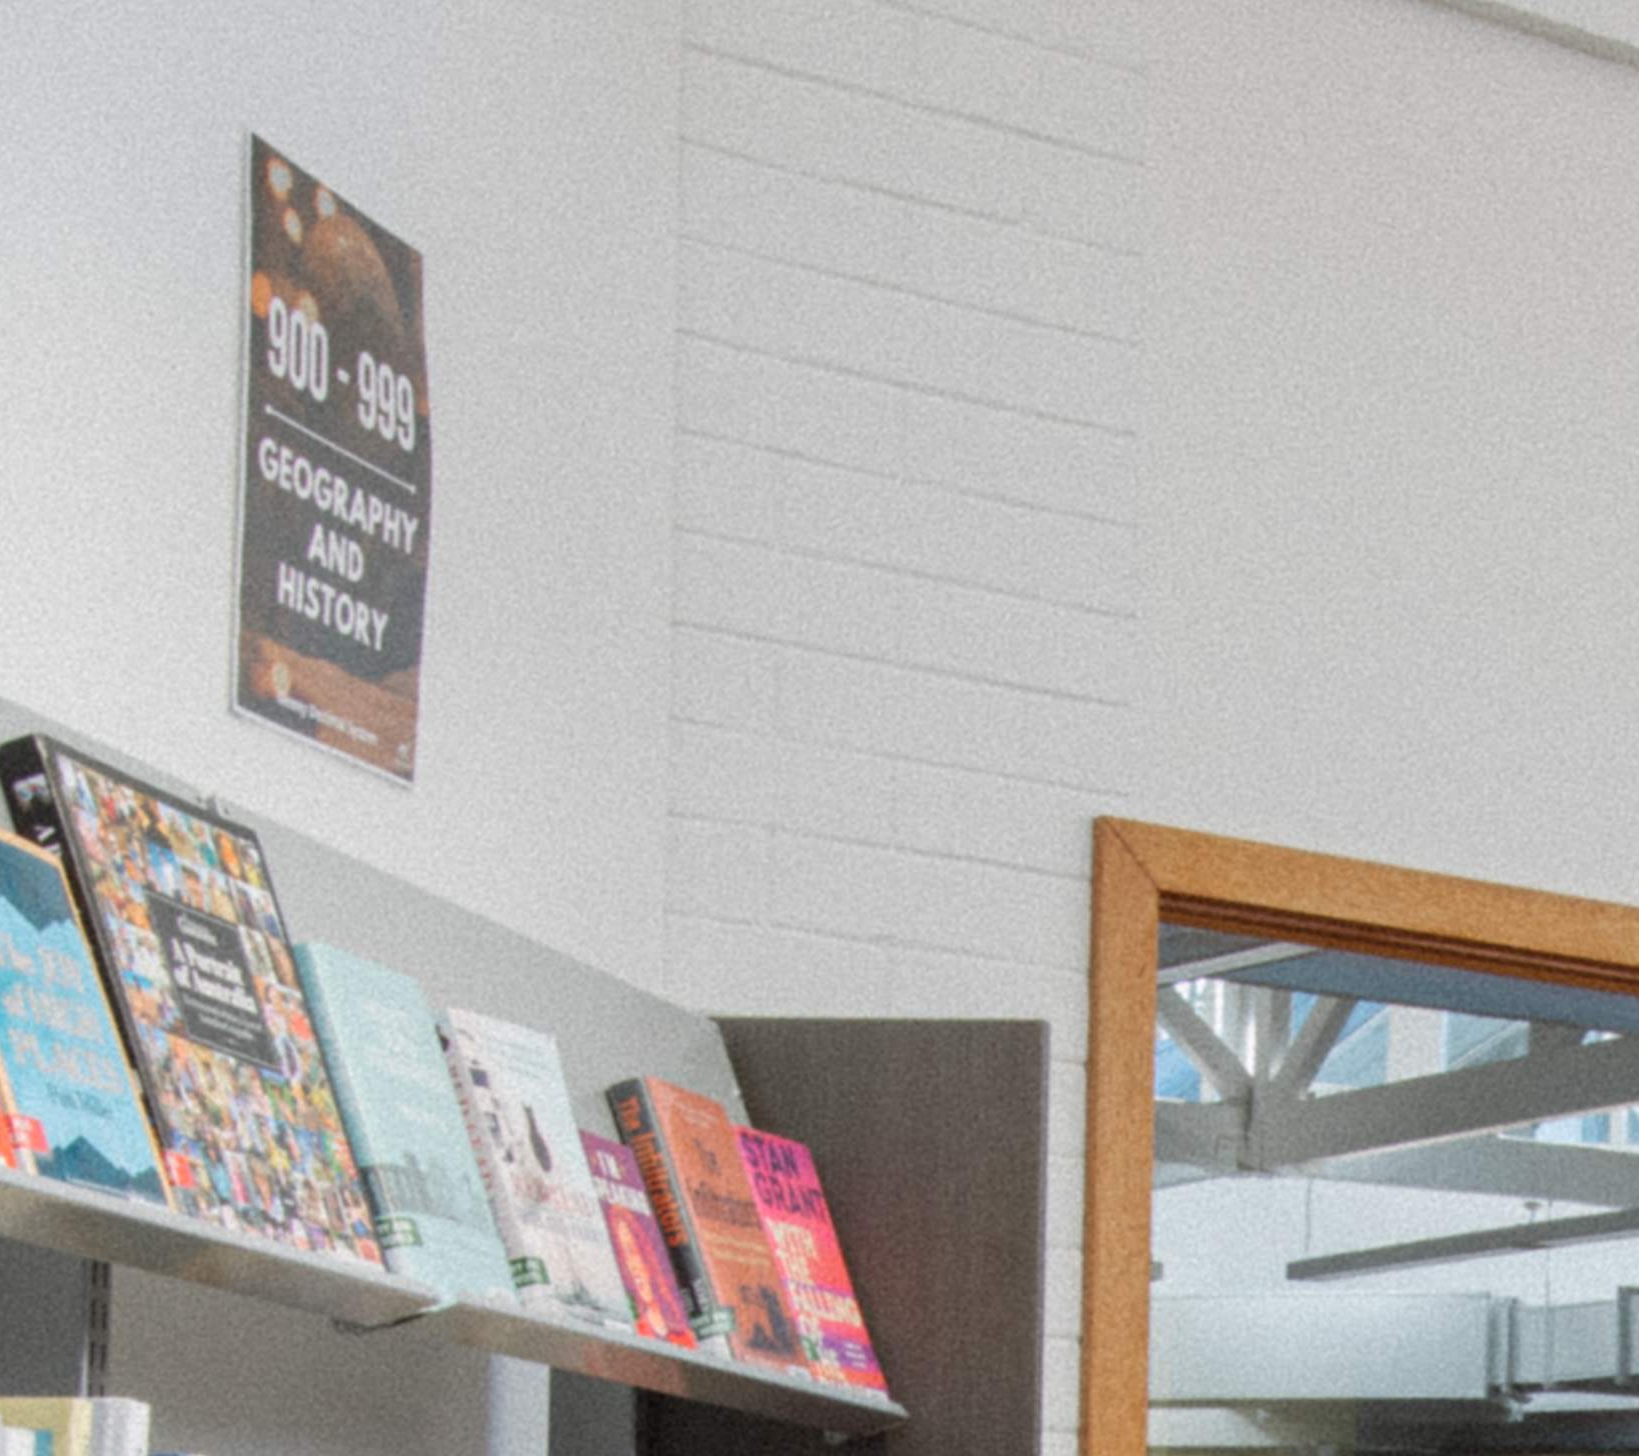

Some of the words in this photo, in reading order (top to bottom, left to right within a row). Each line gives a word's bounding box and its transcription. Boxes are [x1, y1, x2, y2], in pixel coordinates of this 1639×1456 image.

[267, 296, 328, 401] 900
[357, 352, 415, 451] 999
[259, 438, 419, 554] GEOGRAPHY
[308, 524, 364, 583] AND
[278, 562, 389, 651] HISTORY
[741, 1131, 799, 1177] STAN
[754, 1175, 830, 1224] GRANT
